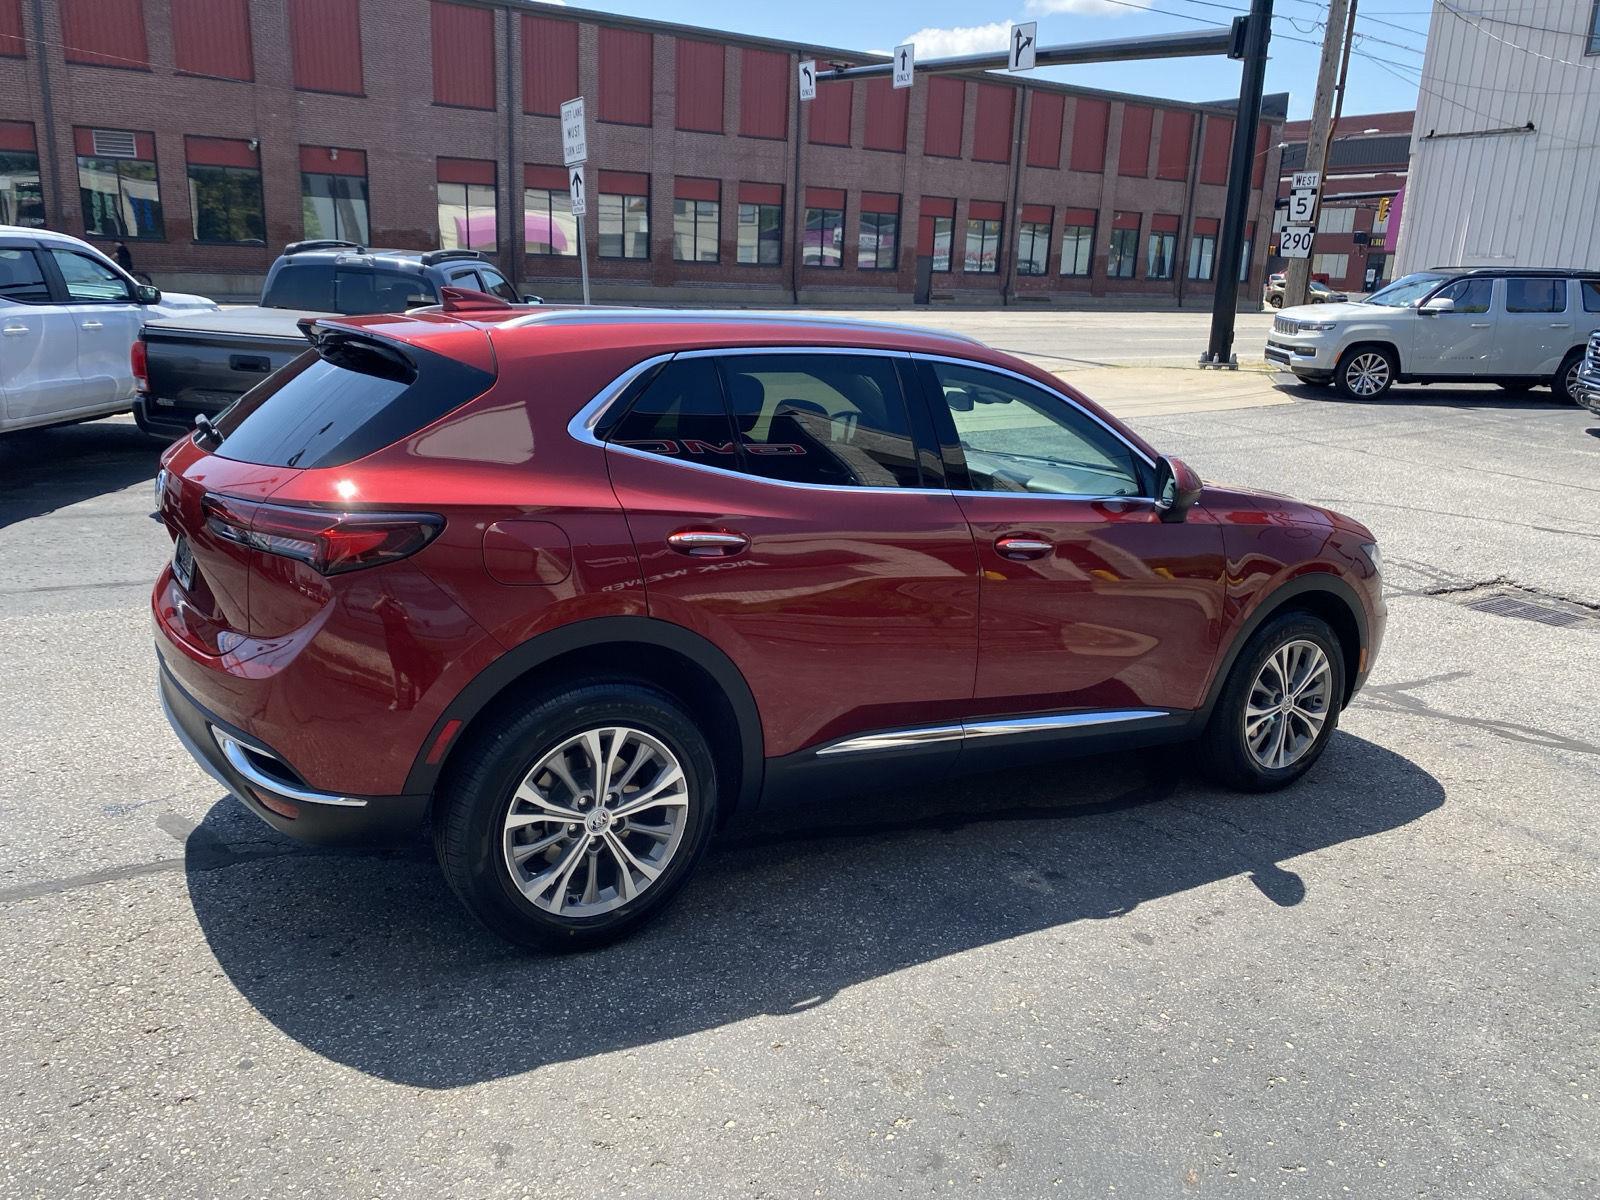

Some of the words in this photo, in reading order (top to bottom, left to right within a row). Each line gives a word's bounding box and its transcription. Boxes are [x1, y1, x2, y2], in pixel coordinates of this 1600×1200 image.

[897, 73, 911, 82] ONLY
[567, 125, 580, 138] MUST
[565, 146, 575, 157] TURN
[576, 143, 585, 154] LEFT
[1296, 176, 1316, 186] WEST
[1296, 198, 1307, 214] 5
[1282, 233, 1311, 250] 290
